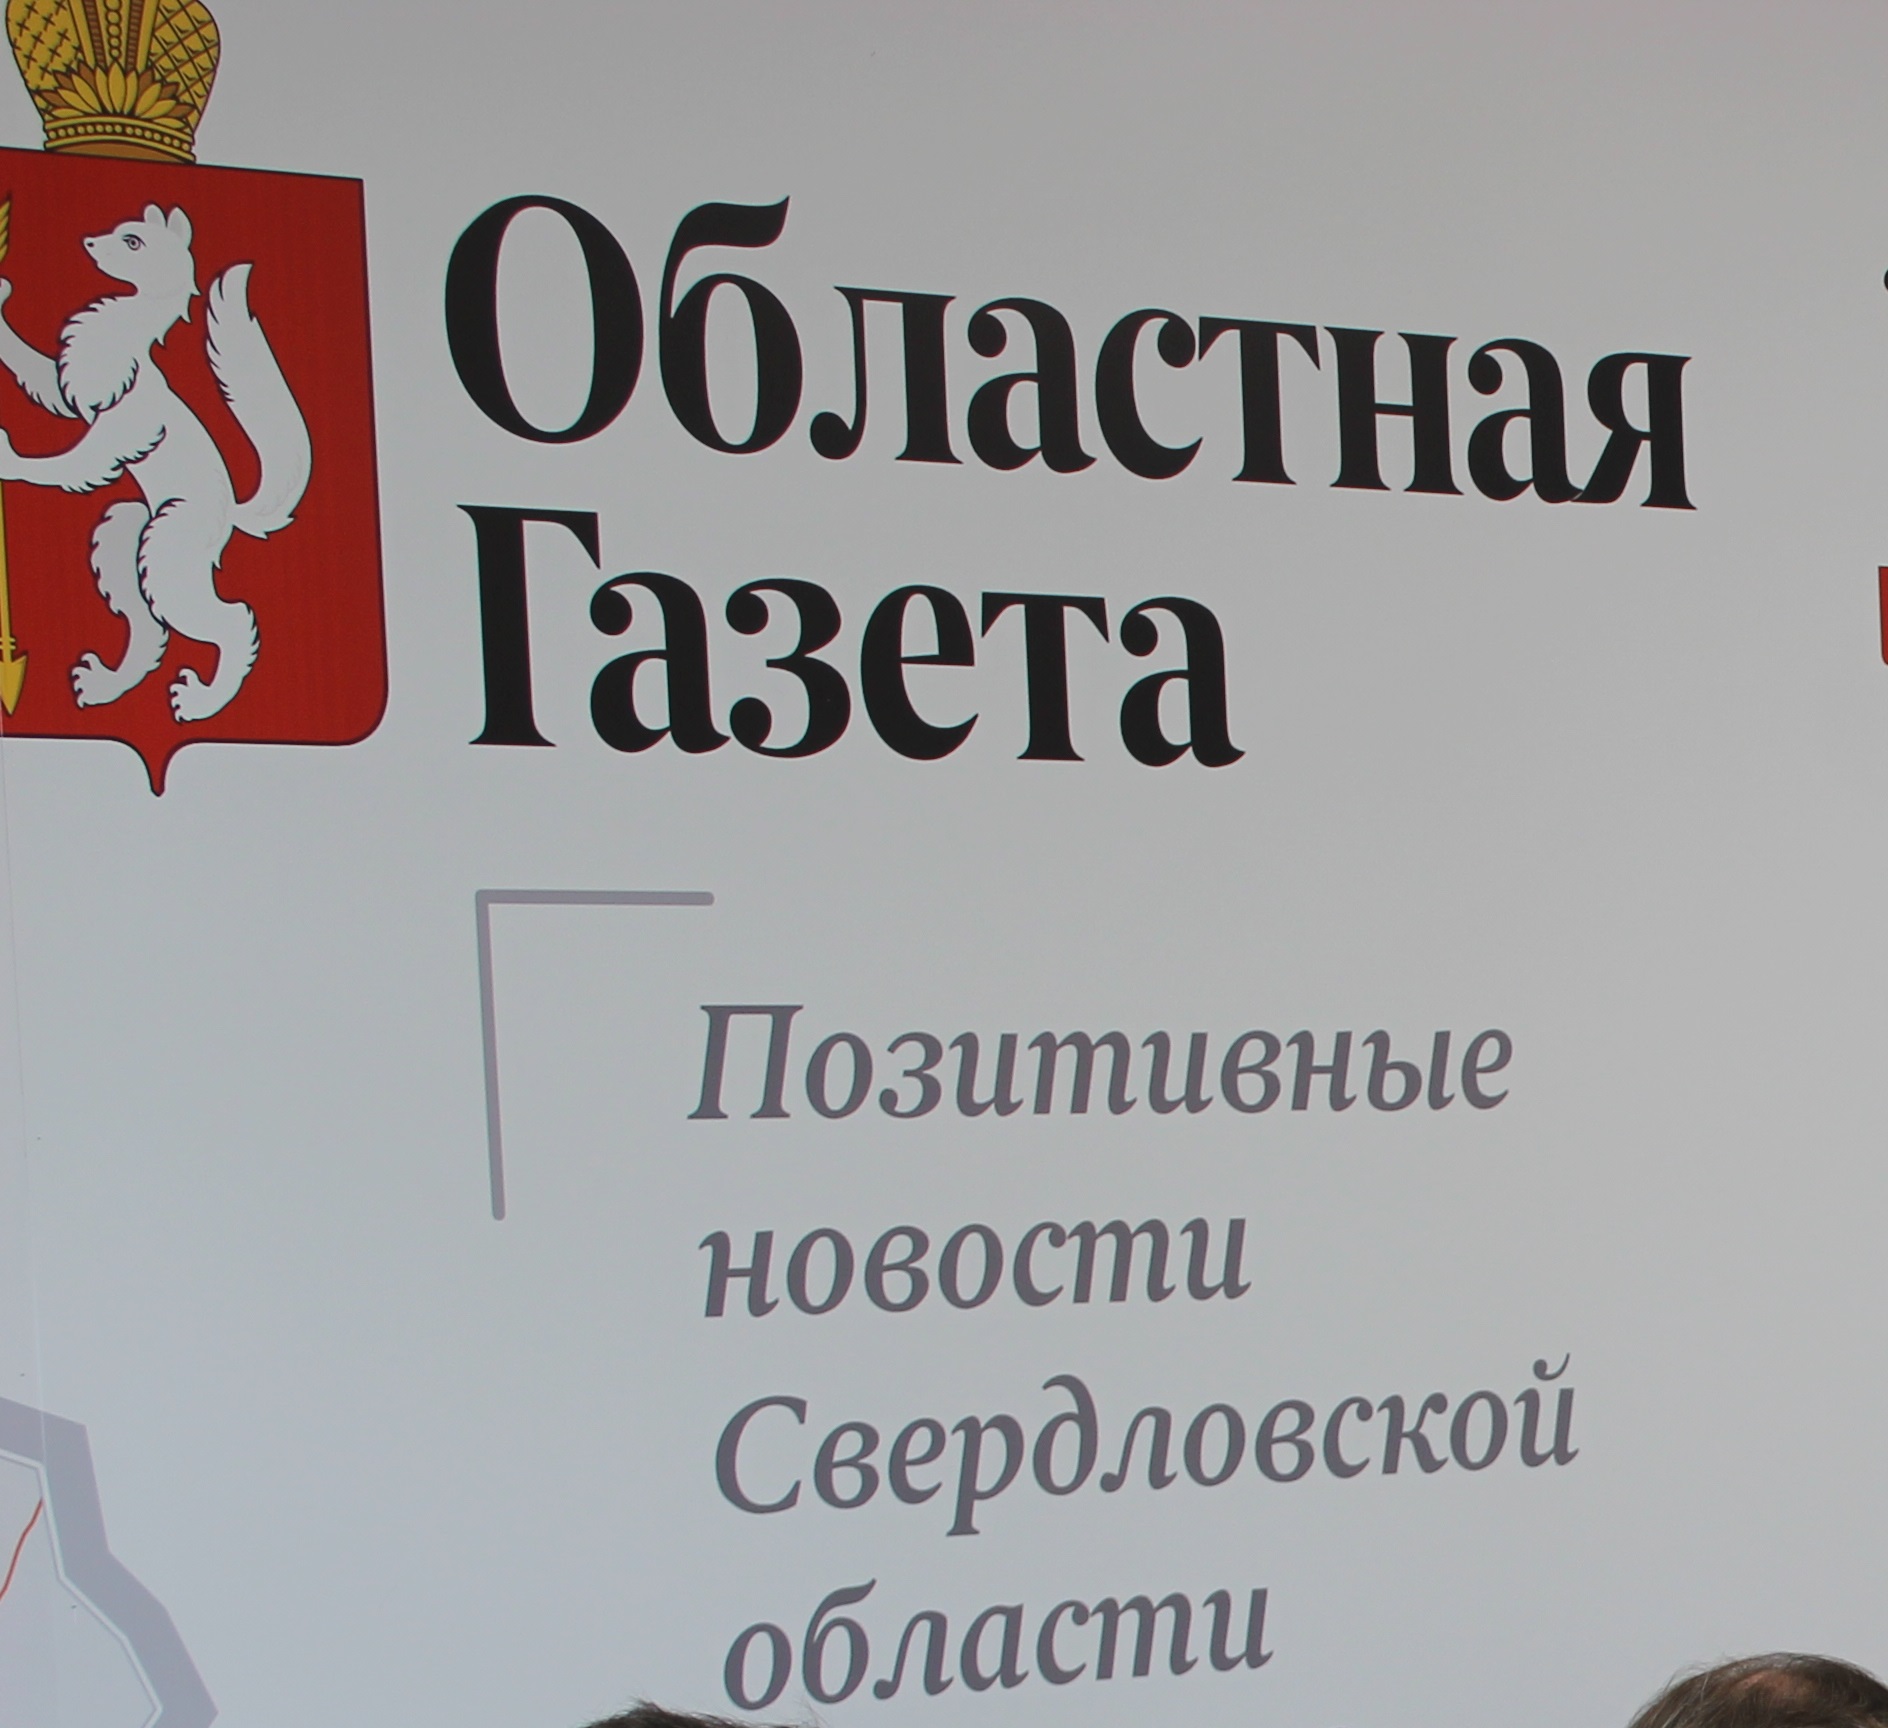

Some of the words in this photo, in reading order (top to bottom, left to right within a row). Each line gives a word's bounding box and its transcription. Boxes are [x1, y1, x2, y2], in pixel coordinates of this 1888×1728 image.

[444, 194, 1697, 511] Областная
[456, 504, 1246, 768] Газета
[687, 1004, 1513, 1120] Позитивные
[698, 1217, 1252, 1318] новости
[715, 1353, 1579, 1537] Свердловской
[722, 1578, 1273, 1711] области
